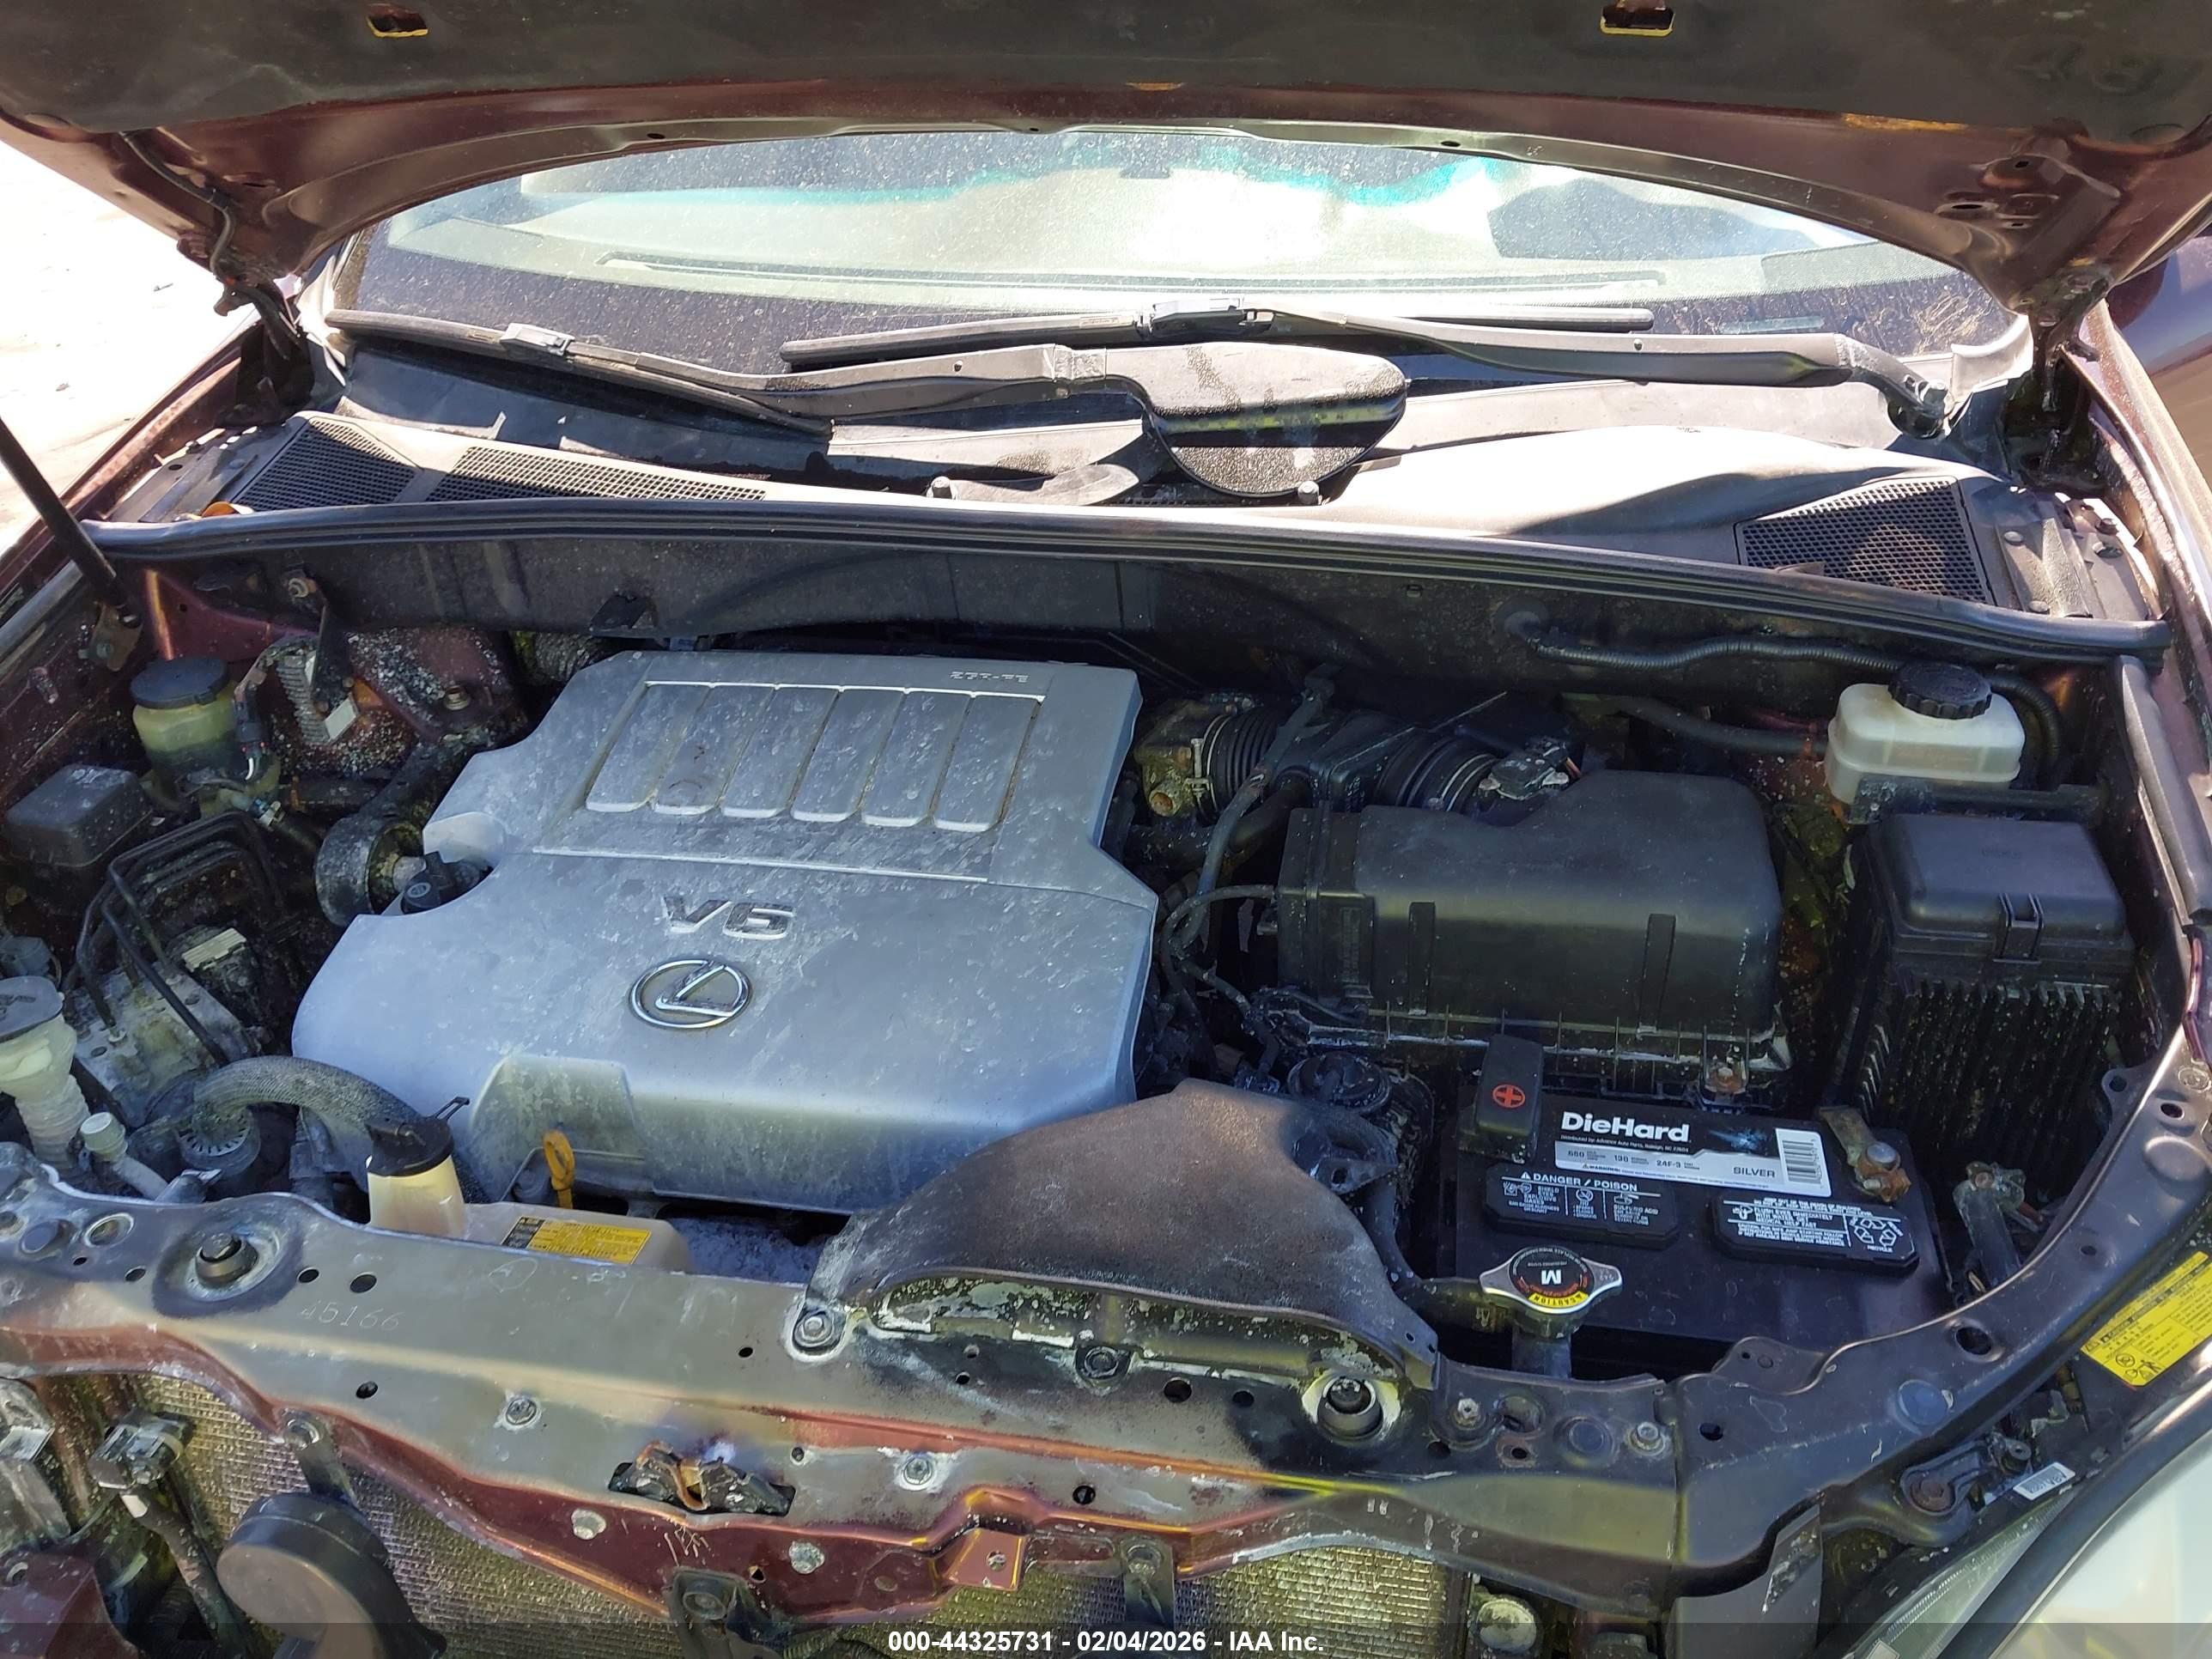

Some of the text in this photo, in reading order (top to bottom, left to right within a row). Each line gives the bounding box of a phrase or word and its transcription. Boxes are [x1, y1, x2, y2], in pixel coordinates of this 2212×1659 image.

[661, 896, 796, 939] V6
[1561, 1111, 1690, 1143] DieHard
[1733, 1166, 1776, 1178] SILVER
[1533, 1173, 1582, 1186] DANGER
[1594, 1179, 1638, 1192] POISON
[1541, 1269, 1562, 1285] M
